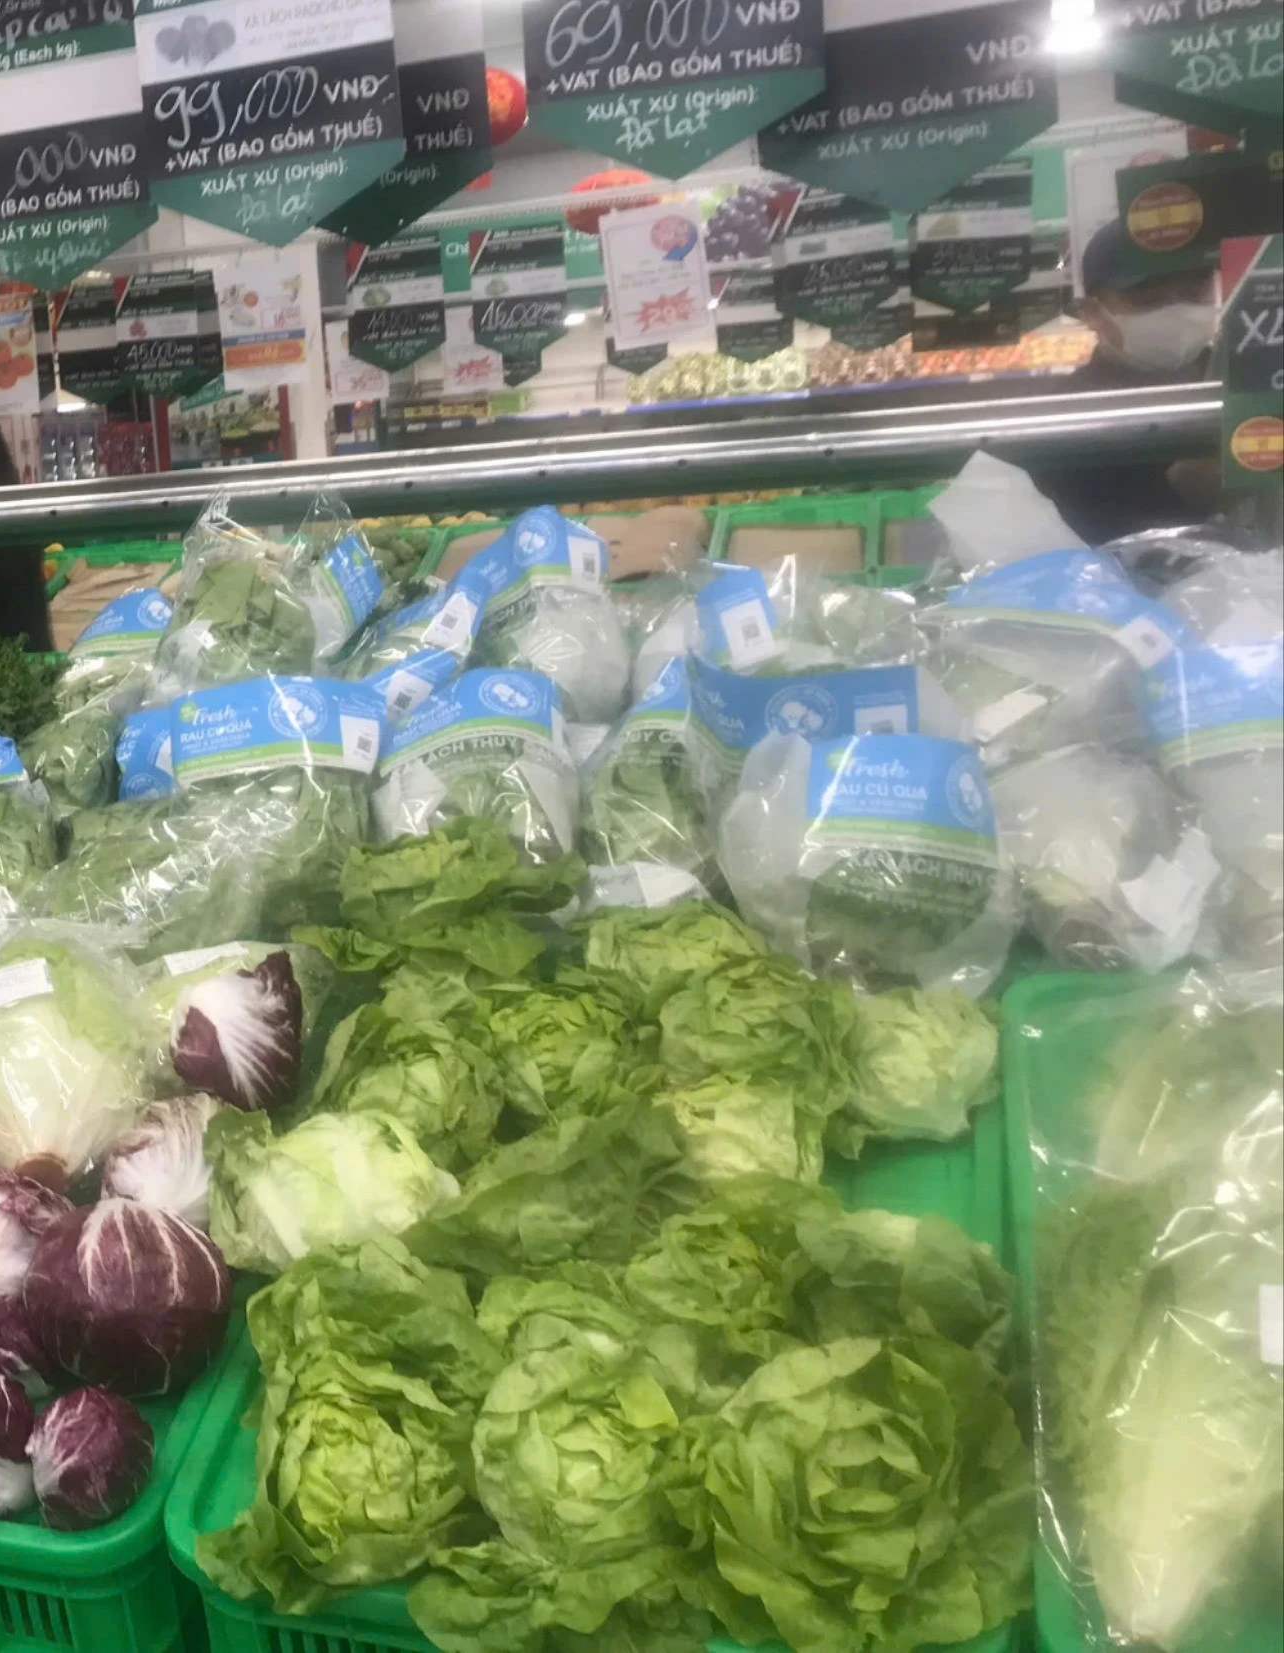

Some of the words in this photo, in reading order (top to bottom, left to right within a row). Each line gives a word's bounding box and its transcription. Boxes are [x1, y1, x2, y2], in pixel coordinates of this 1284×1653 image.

[608, 62, 663, 88] (BAO
[89, 144, 137, 169] VNĐ
[217, 139, 264, 165] (BAO
[0, 196, 39, 218] (BAO
